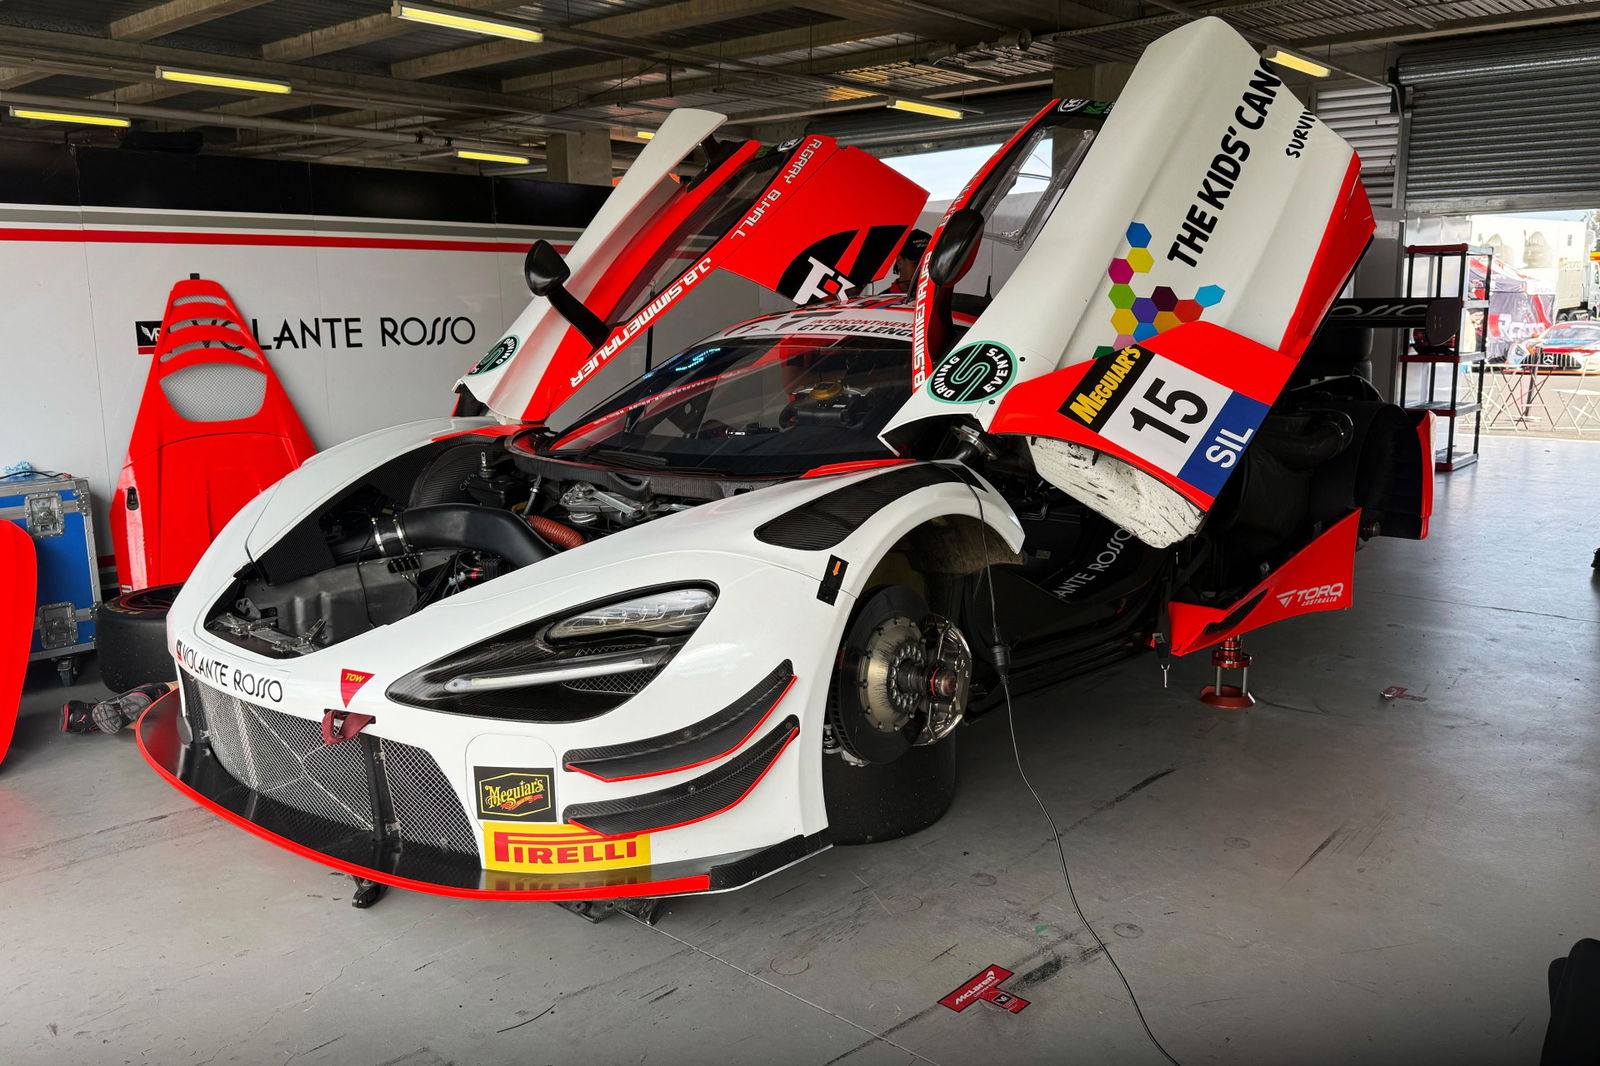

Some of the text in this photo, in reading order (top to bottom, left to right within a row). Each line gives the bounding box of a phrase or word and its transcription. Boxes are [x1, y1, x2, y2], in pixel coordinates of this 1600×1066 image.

[784, 139, 823, 184] R.GRAY
[730, 189, 781, 239] B.HALL
[1167, 204, 1218, 267] THE
[1197, 125, 1250, 211] KIDS'
[380, 316, 476, 347] ROSSO
[569, 257, 712, 388] J.B.SIMMENAUER
[934, 355, 960, 398] DRIVING
[983, 348, 1009, 393] EVENTS
[1130, 377, 1208, 444] 15
[1205, 428, 1254, 468] SIL
[1297, 583, 1344, 602] TORQ
[183, 644, 229, 687] VOLANTE
[233, 669, 283, 702] ROSSO
[345, 673, 365, 682] TOW
[485, 778, 544, 809] Meguiar's
[494, 831, 639, 864] PIRELLI
[956, 974, 995, 1005] McLaren
